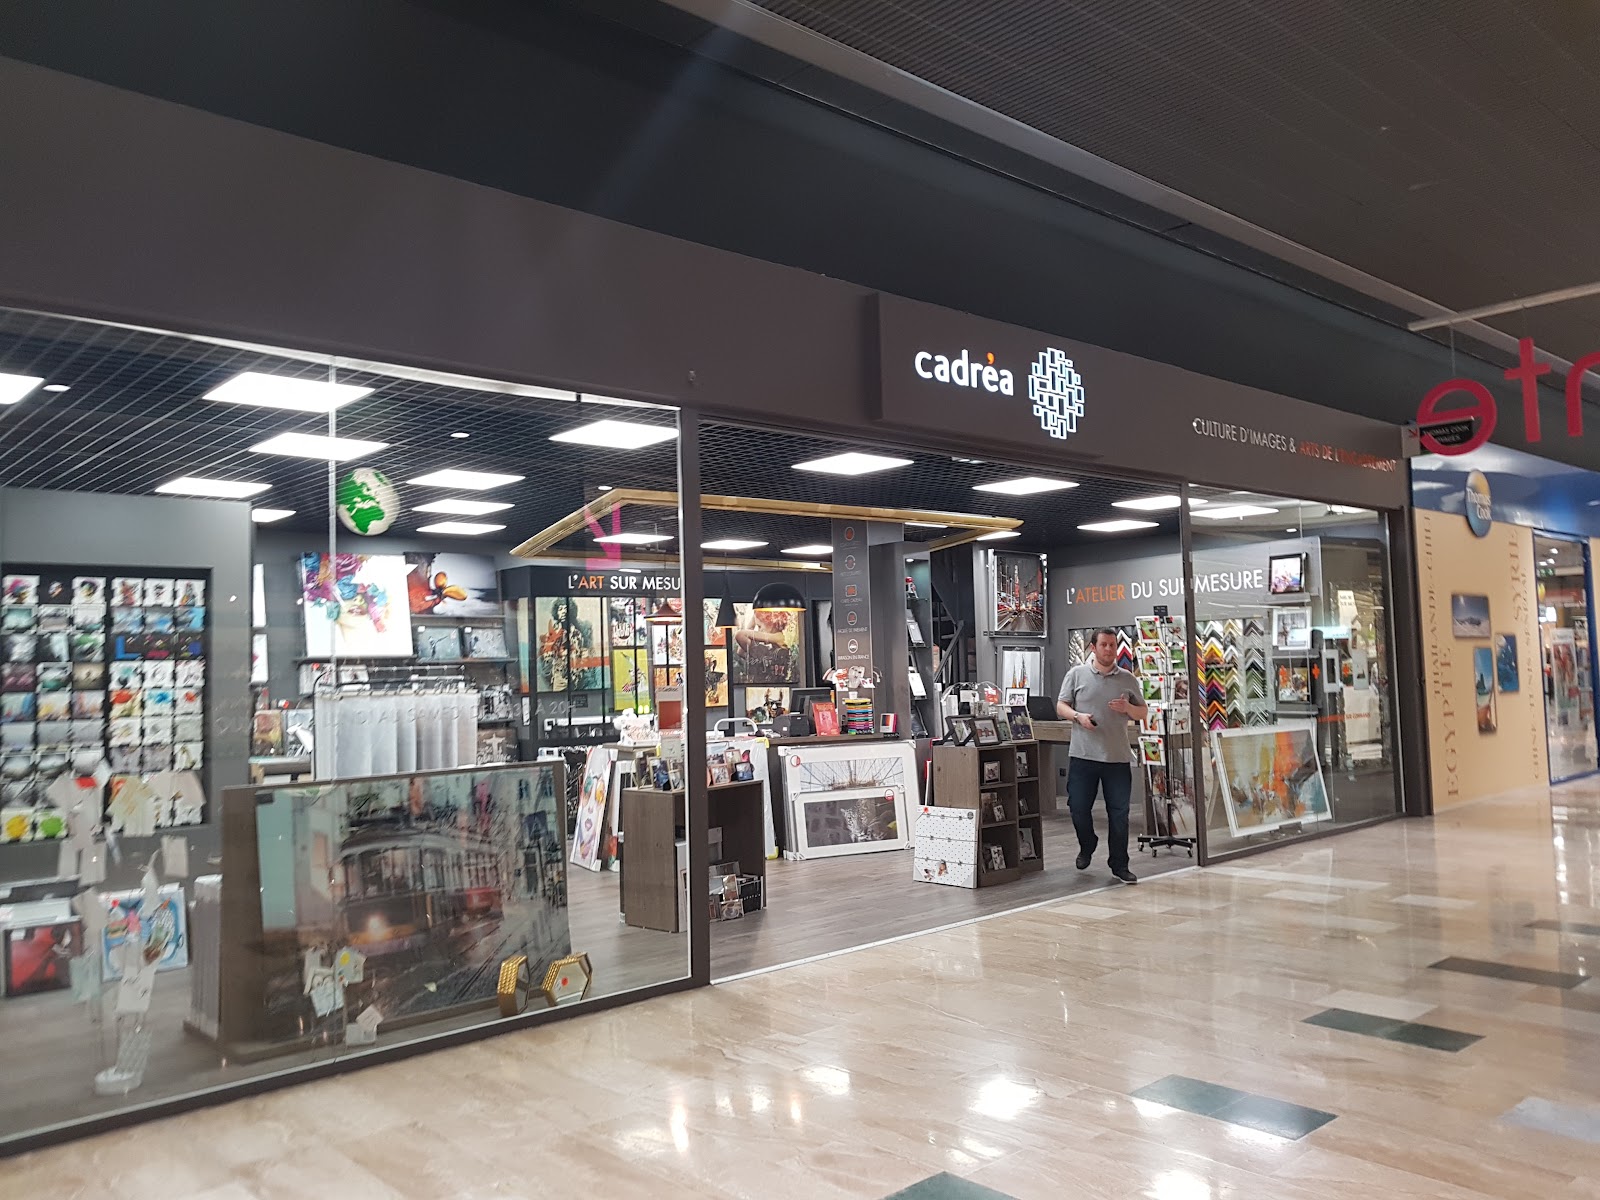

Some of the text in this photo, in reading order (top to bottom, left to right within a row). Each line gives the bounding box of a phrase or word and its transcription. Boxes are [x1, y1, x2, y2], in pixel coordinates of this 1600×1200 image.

[1192, 418, 1237, 441] CULTURE
[1240, 427, 1287, 451] D'IMAGES
[1289, 437, 1297, 453] &
[1300, 441, 1320, 458] ARTS
[1322, 445, 1333, 461] DE
[568, 575, 681, 590] L'ART SUR MESU
[1066, 583, 1126, 605] L'ATELIER
[1131, 580, 1153, 599] DU
[1194, 569, 1264, 593] MESURE
[1508, 528, 1522, 621] SYRIE
[1440, 647, 1459, 797] EGYPTE
